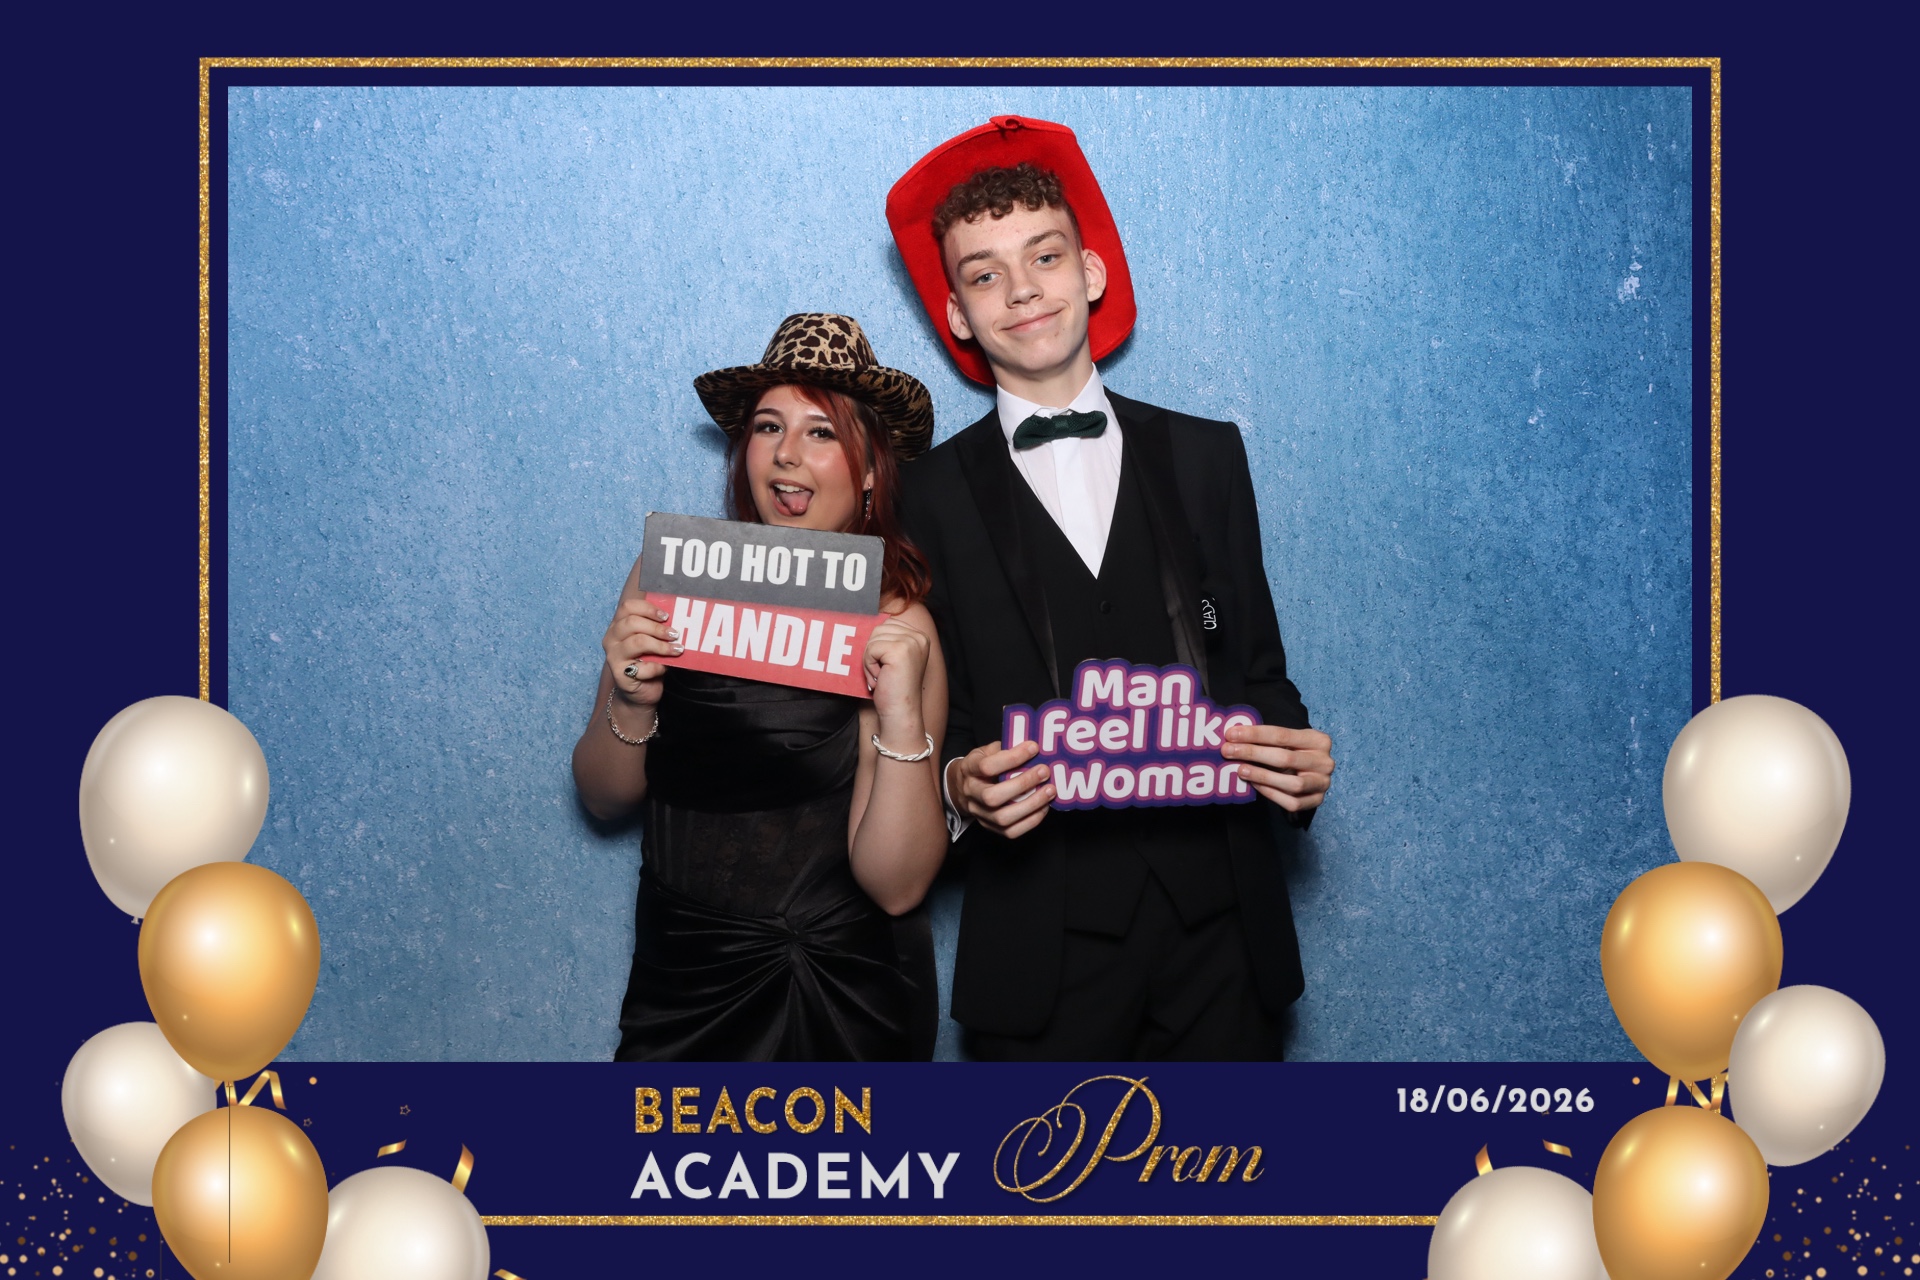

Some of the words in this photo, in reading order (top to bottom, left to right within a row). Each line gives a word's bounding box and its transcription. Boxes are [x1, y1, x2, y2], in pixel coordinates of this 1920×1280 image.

[660, 536, 732, 580] TOO
[740, 544, 815, 587] HOT
[822, 550, 868, 592] TO
[670, 596, 857, 677] HANDLE
[1080, 668, 1192, 708] Man
[1012, 714, 1026, 748] I
[1042, 708, 1146, 752] feel
[1053, 761, 1248, 801] Woman
